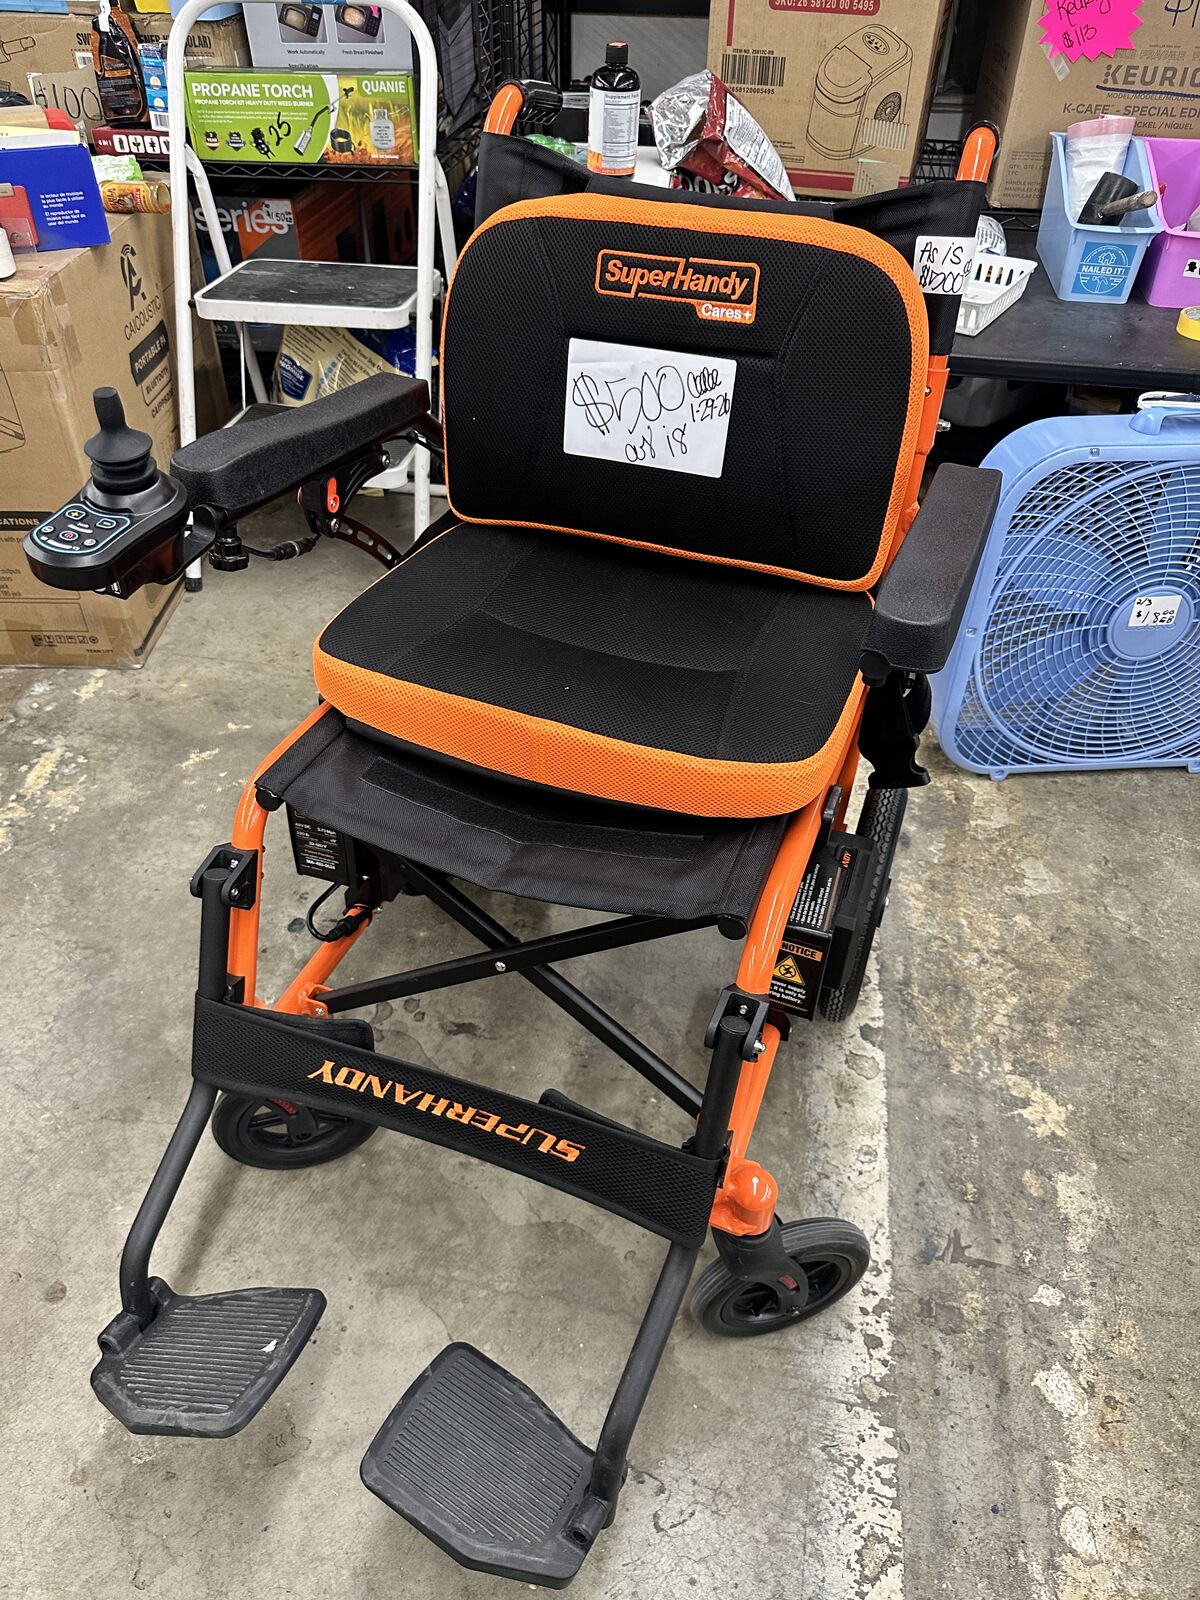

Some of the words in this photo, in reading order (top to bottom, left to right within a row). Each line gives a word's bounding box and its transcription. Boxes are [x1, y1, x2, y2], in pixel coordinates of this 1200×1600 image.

[810, 0, 836, 8] 58120
[840, 0, 850, 9] 00
[852, 0, 874, 11] 5495
[1062, 24, 1097, 48] $113
[192, 82, 260, 97] PROPANE
[262, 84, 313, 98] TORCH
[362, 80, 406, 94] QUANIE
[1123, 105, 1176, 118] SPECIAL
[1134, 120, 1157, 129] ICKEL
[1082, 265, 1113, 274] NAILED
[605, 258, 749, 300] SuperHandy
[573, 366, 685, 436] $500
[782, 942, 817, 958] NOTICE
[307, 1060, 586, 1162] SUPERHANDY
